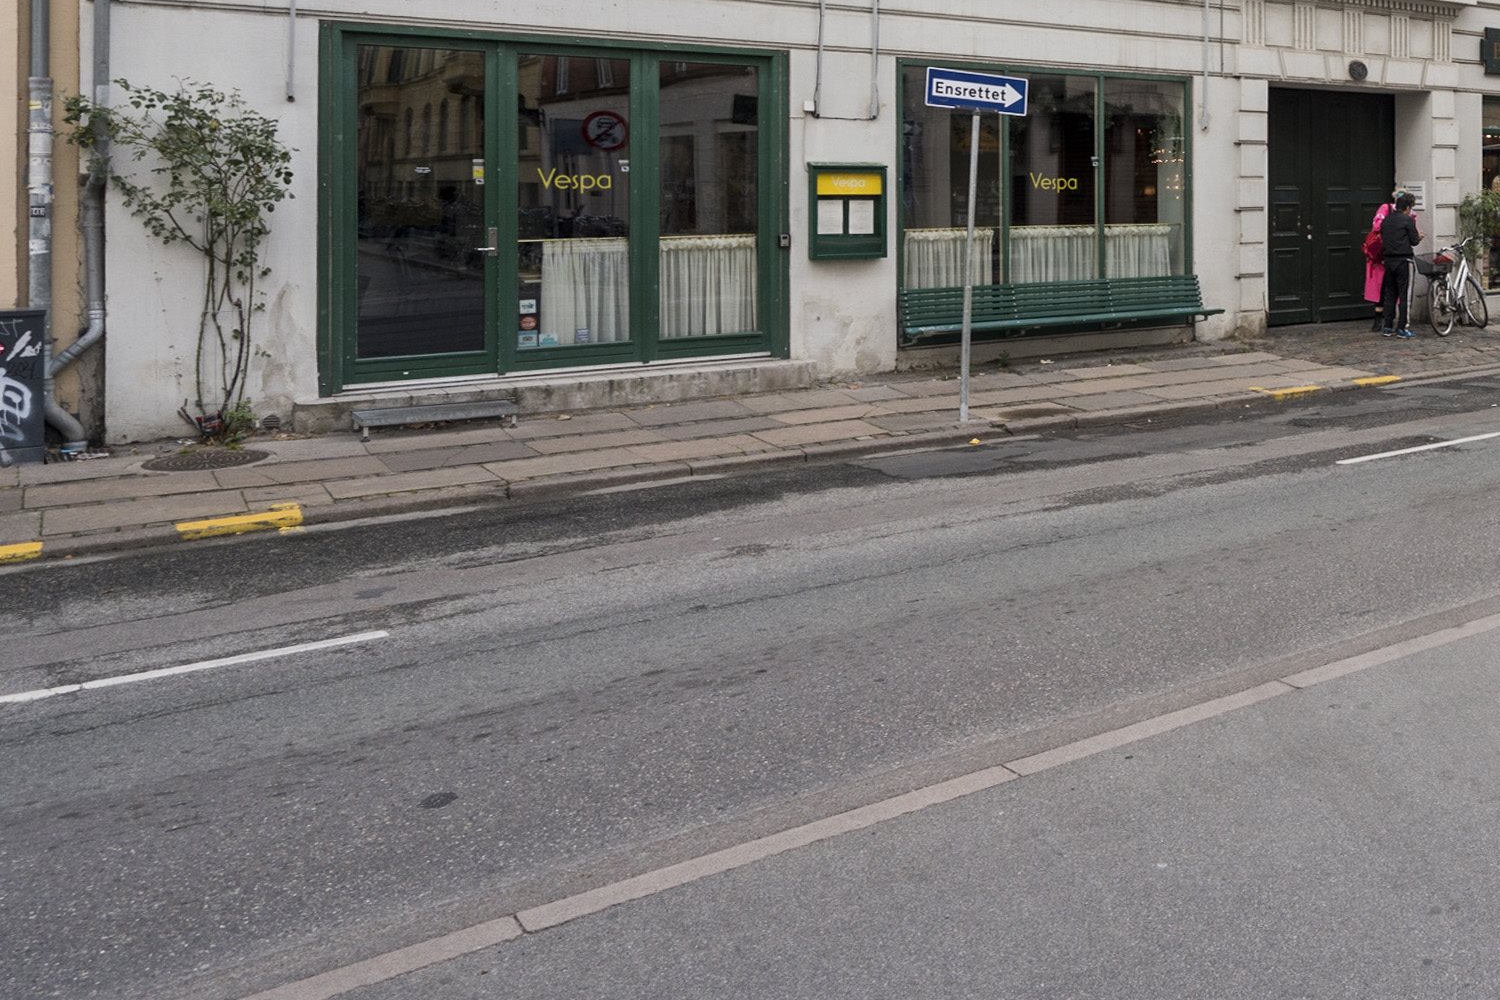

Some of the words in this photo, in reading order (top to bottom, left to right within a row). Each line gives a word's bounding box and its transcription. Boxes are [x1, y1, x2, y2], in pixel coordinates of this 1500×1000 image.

[935, 81, 1007, 101] Ensrettet
[537, 167, 612, 194] Vespa
[831, 175, 866, 188] Vespa
[1029, 172, 1078, 194] Vespa
